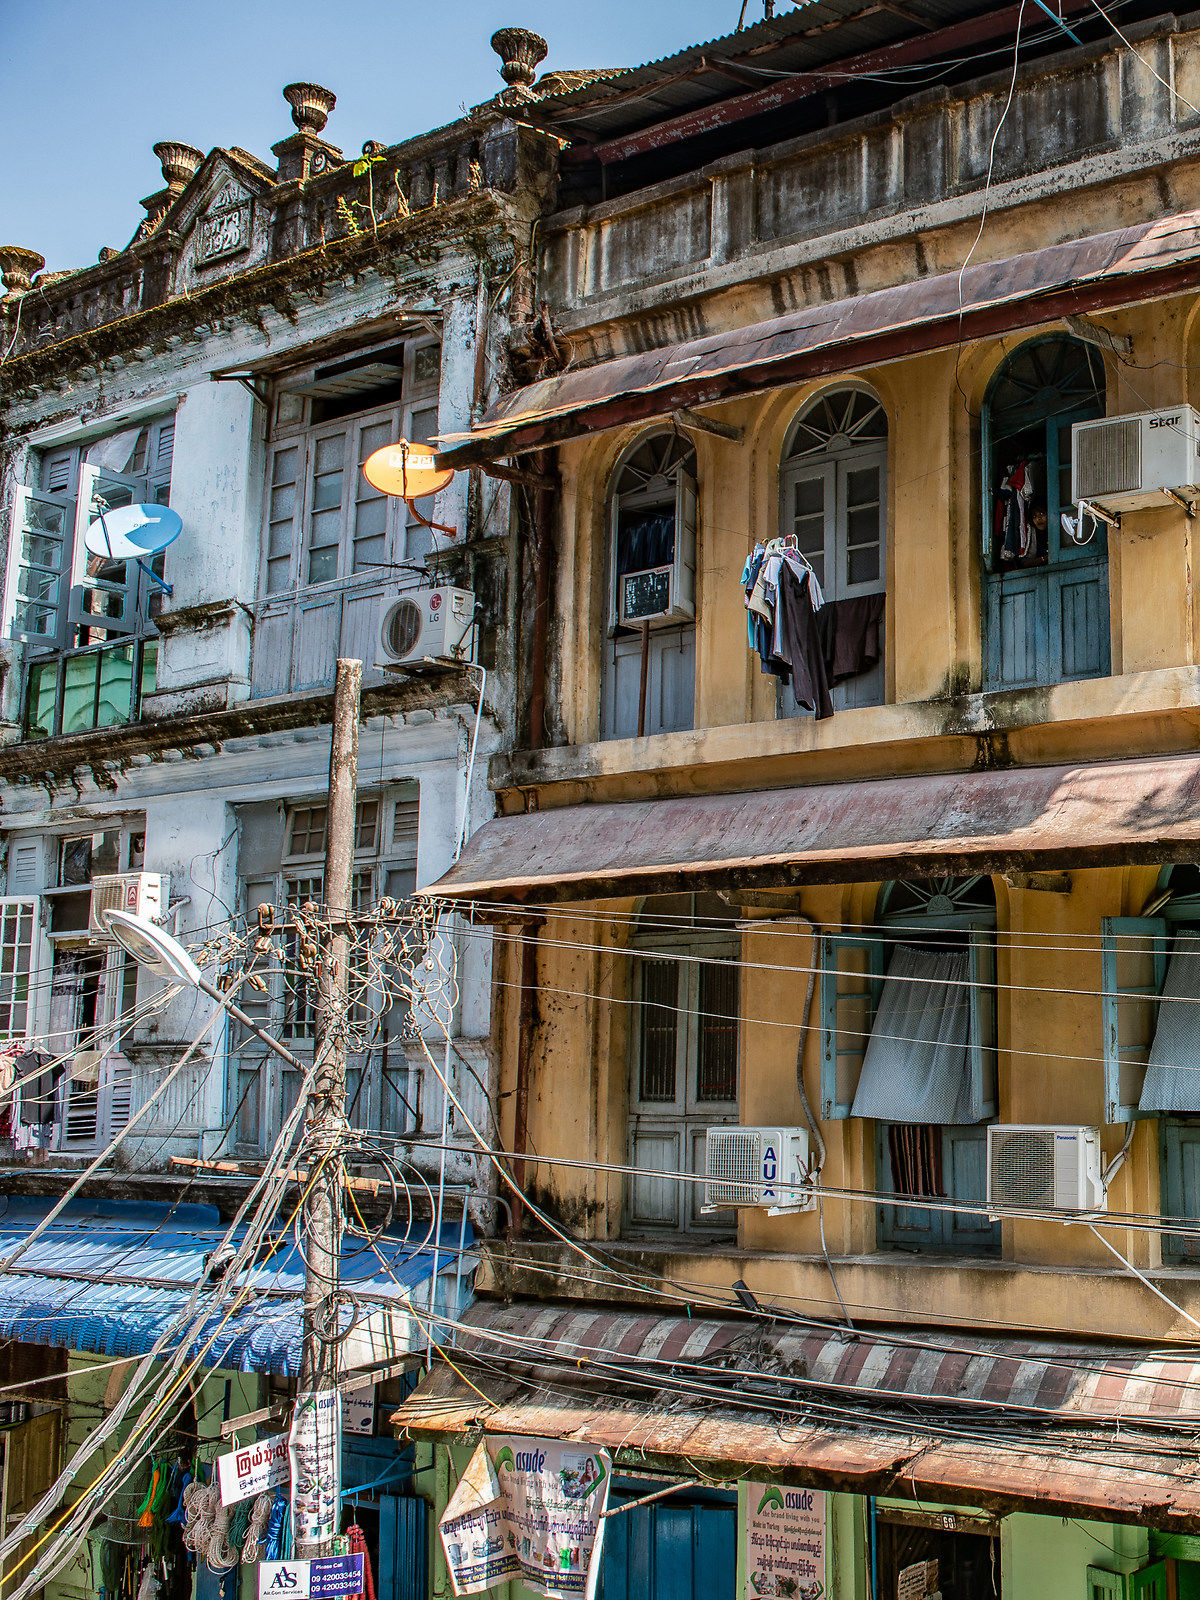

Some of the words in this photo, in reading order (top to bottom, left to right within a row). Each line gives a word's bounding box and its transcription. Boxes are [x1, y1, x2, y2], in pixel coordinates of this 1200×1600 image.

[205, 229, 240, 257] 1920
[1149, 415, 1181, 430] Star
[429, 613, 440, 623] LG
[516, 1448, 545, 1474] asude
[785, 1490, 814, 1511] asude
[771, 1511, 785, 1519] brand
[786, 1512, 799, 1522] living
[311, 1575, 320, 1583] 09
[311, 1585, 320, 1593] 09
